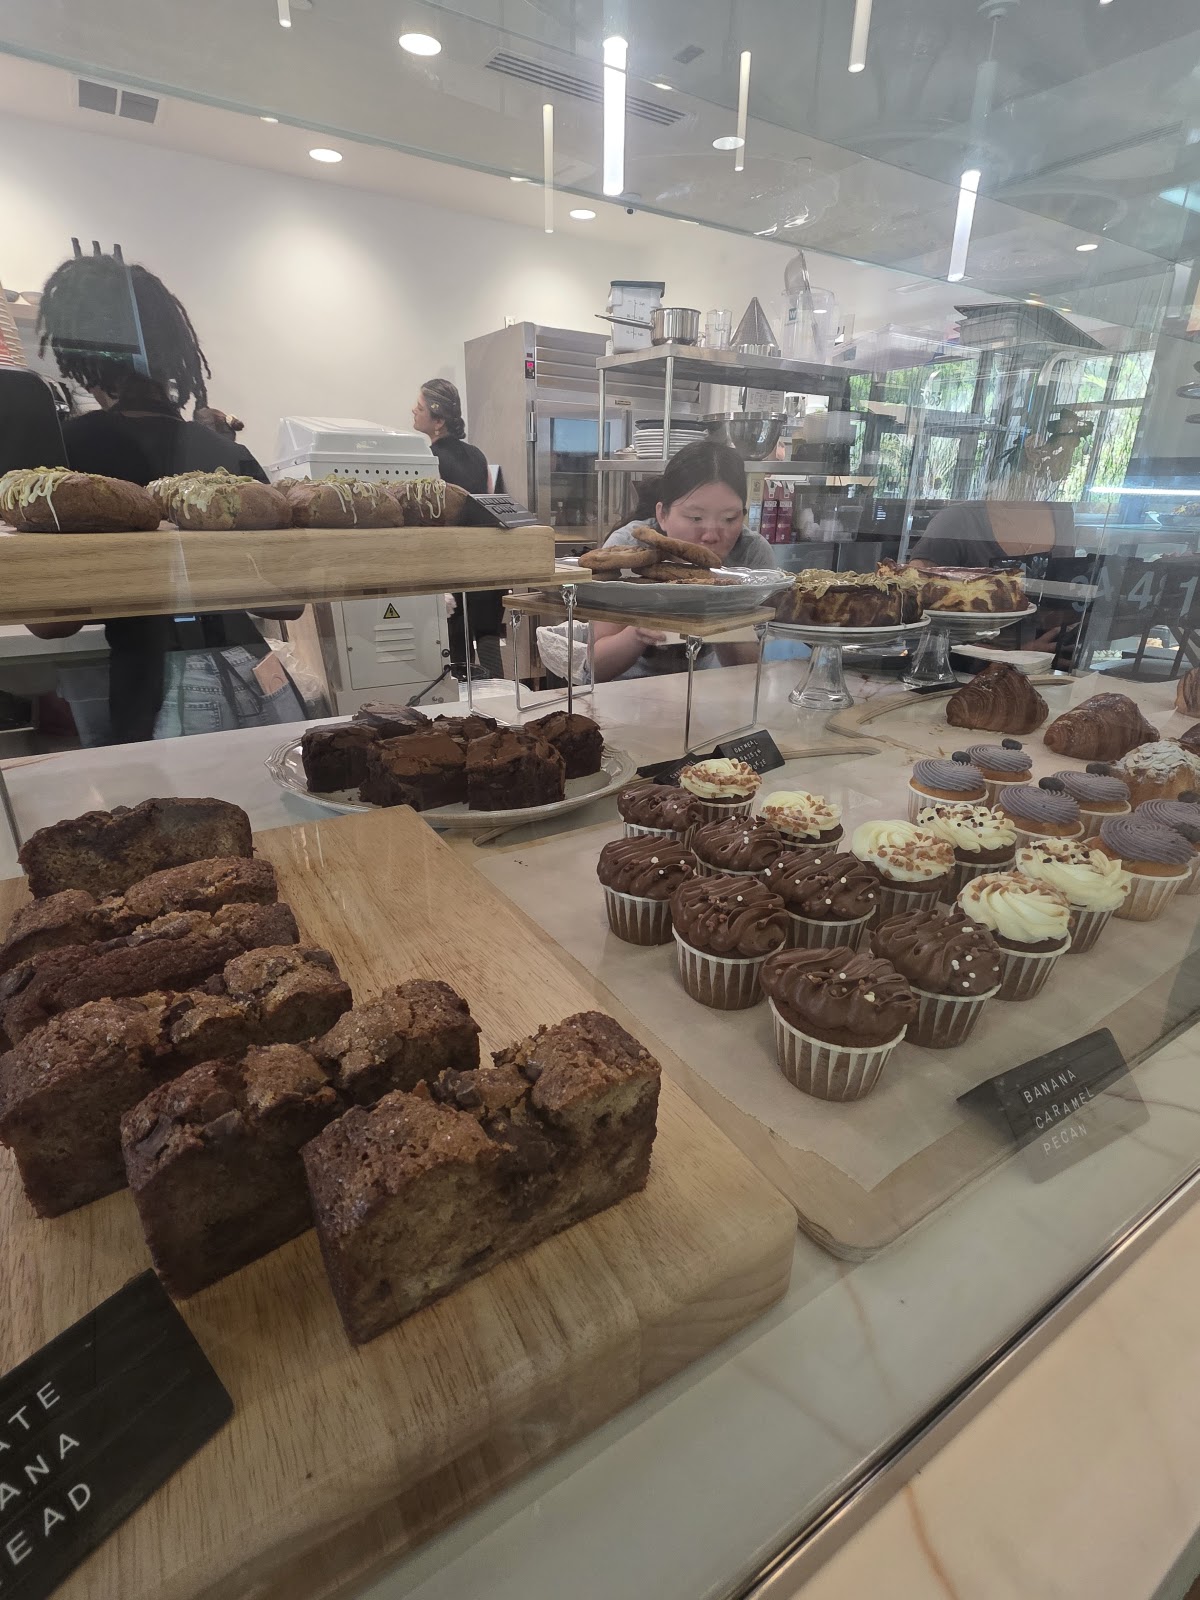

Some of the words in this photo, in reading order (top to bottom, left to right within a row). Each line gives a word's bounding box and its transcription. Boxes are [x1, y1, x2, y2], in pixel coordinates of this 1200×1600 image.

[734, 740, 758, 753] OATMEAL
[739, 749, 761, 761] RAISIN
[1024, 1070, 1077, 1104] BANANA
[1035, 1087, 1095, 1129] CARAMEL
[1043, 1123, 1088, 1155] PECAN
